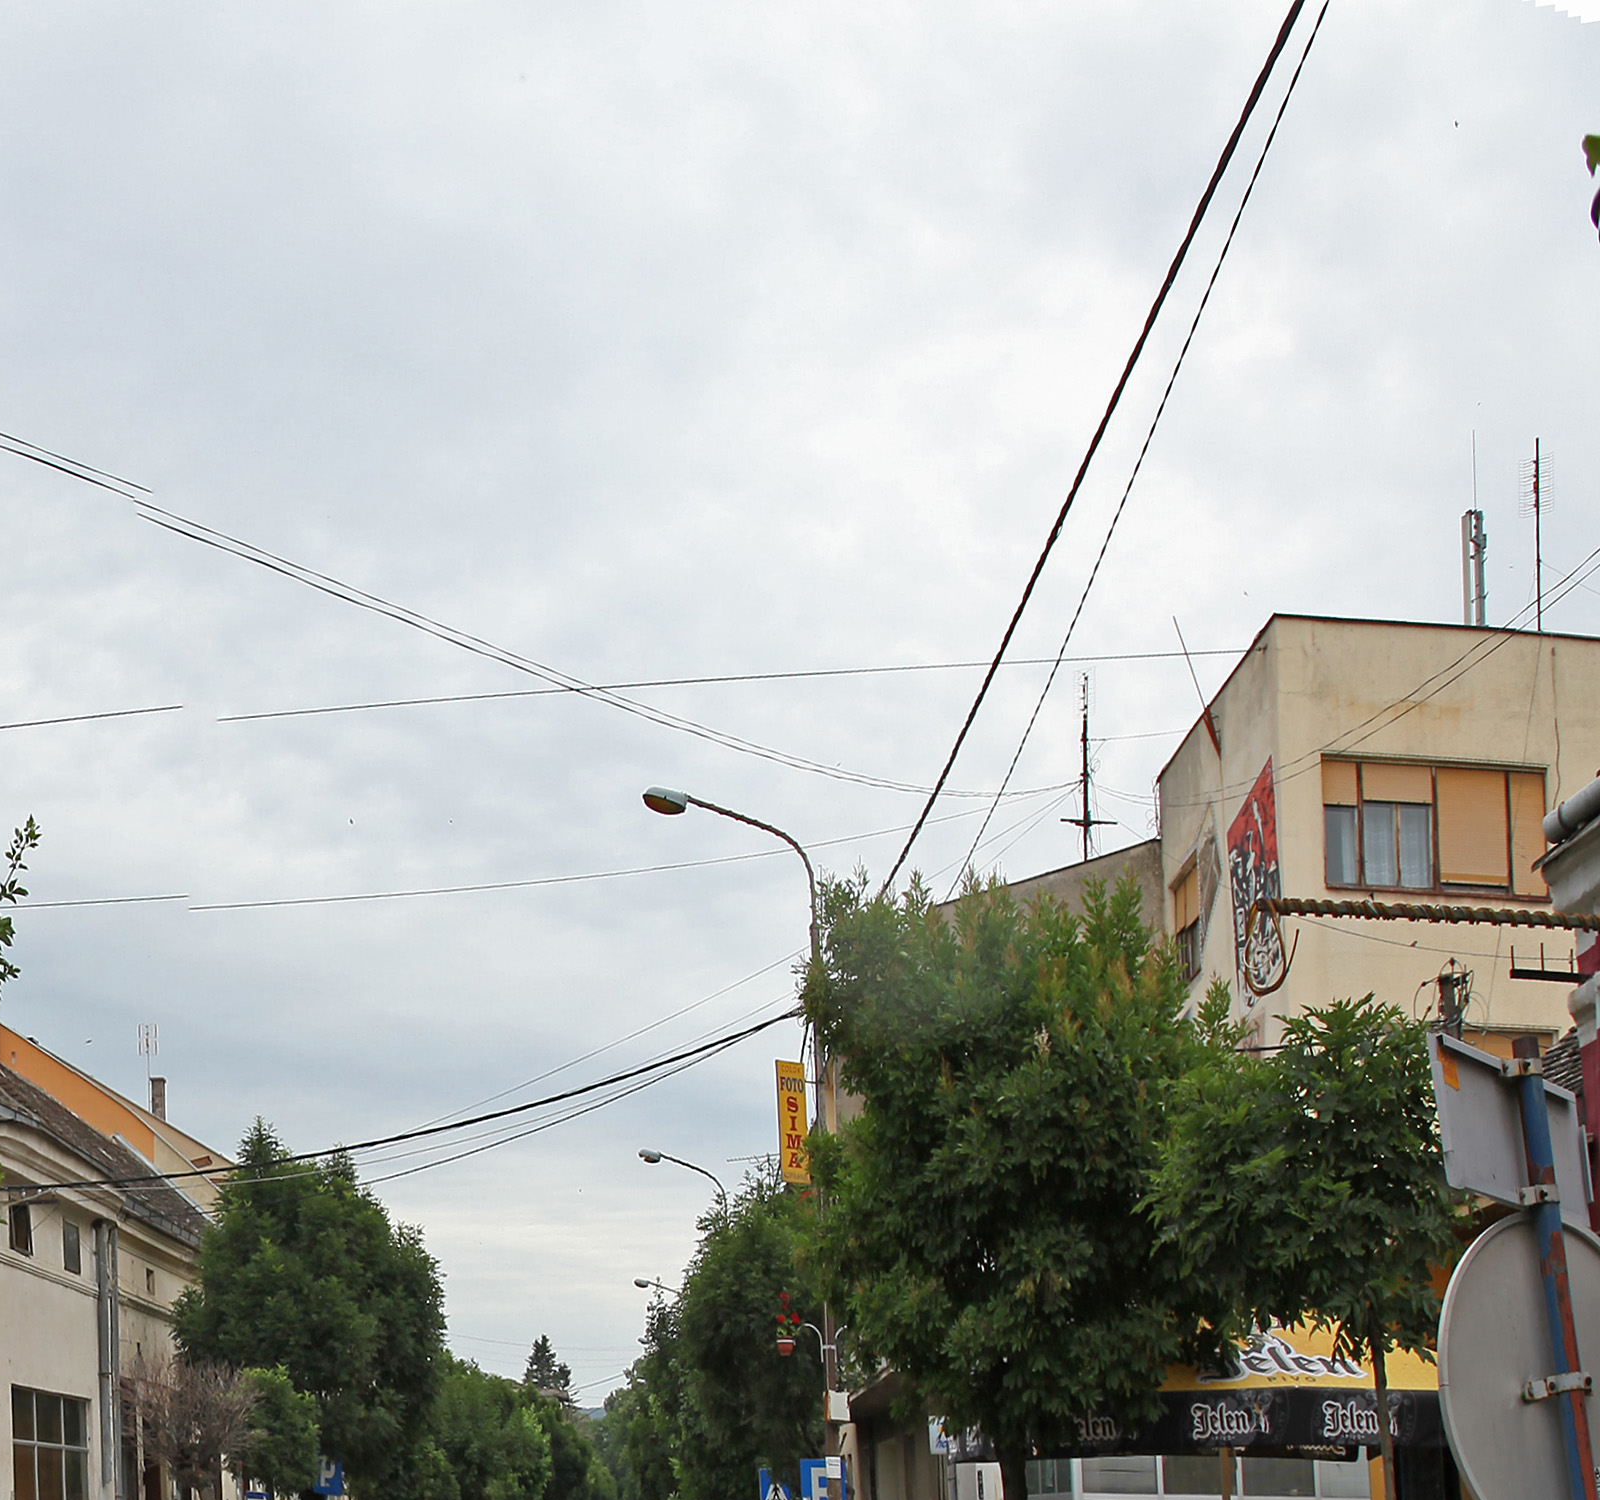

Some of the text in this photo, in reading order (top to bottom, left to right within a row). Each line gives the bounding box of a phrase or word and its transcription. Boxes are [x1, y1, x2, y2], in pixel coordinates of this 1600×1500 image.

[780, 1076, 804, 1092] FOTO
[786, 1096, 803, 1168] SIMA
[1267, 1375, 1317, 1383] PIVO
[1191, 1402, 1251, 1440] Jelen
[1322, 1400, 1380, 1438] Jelen
